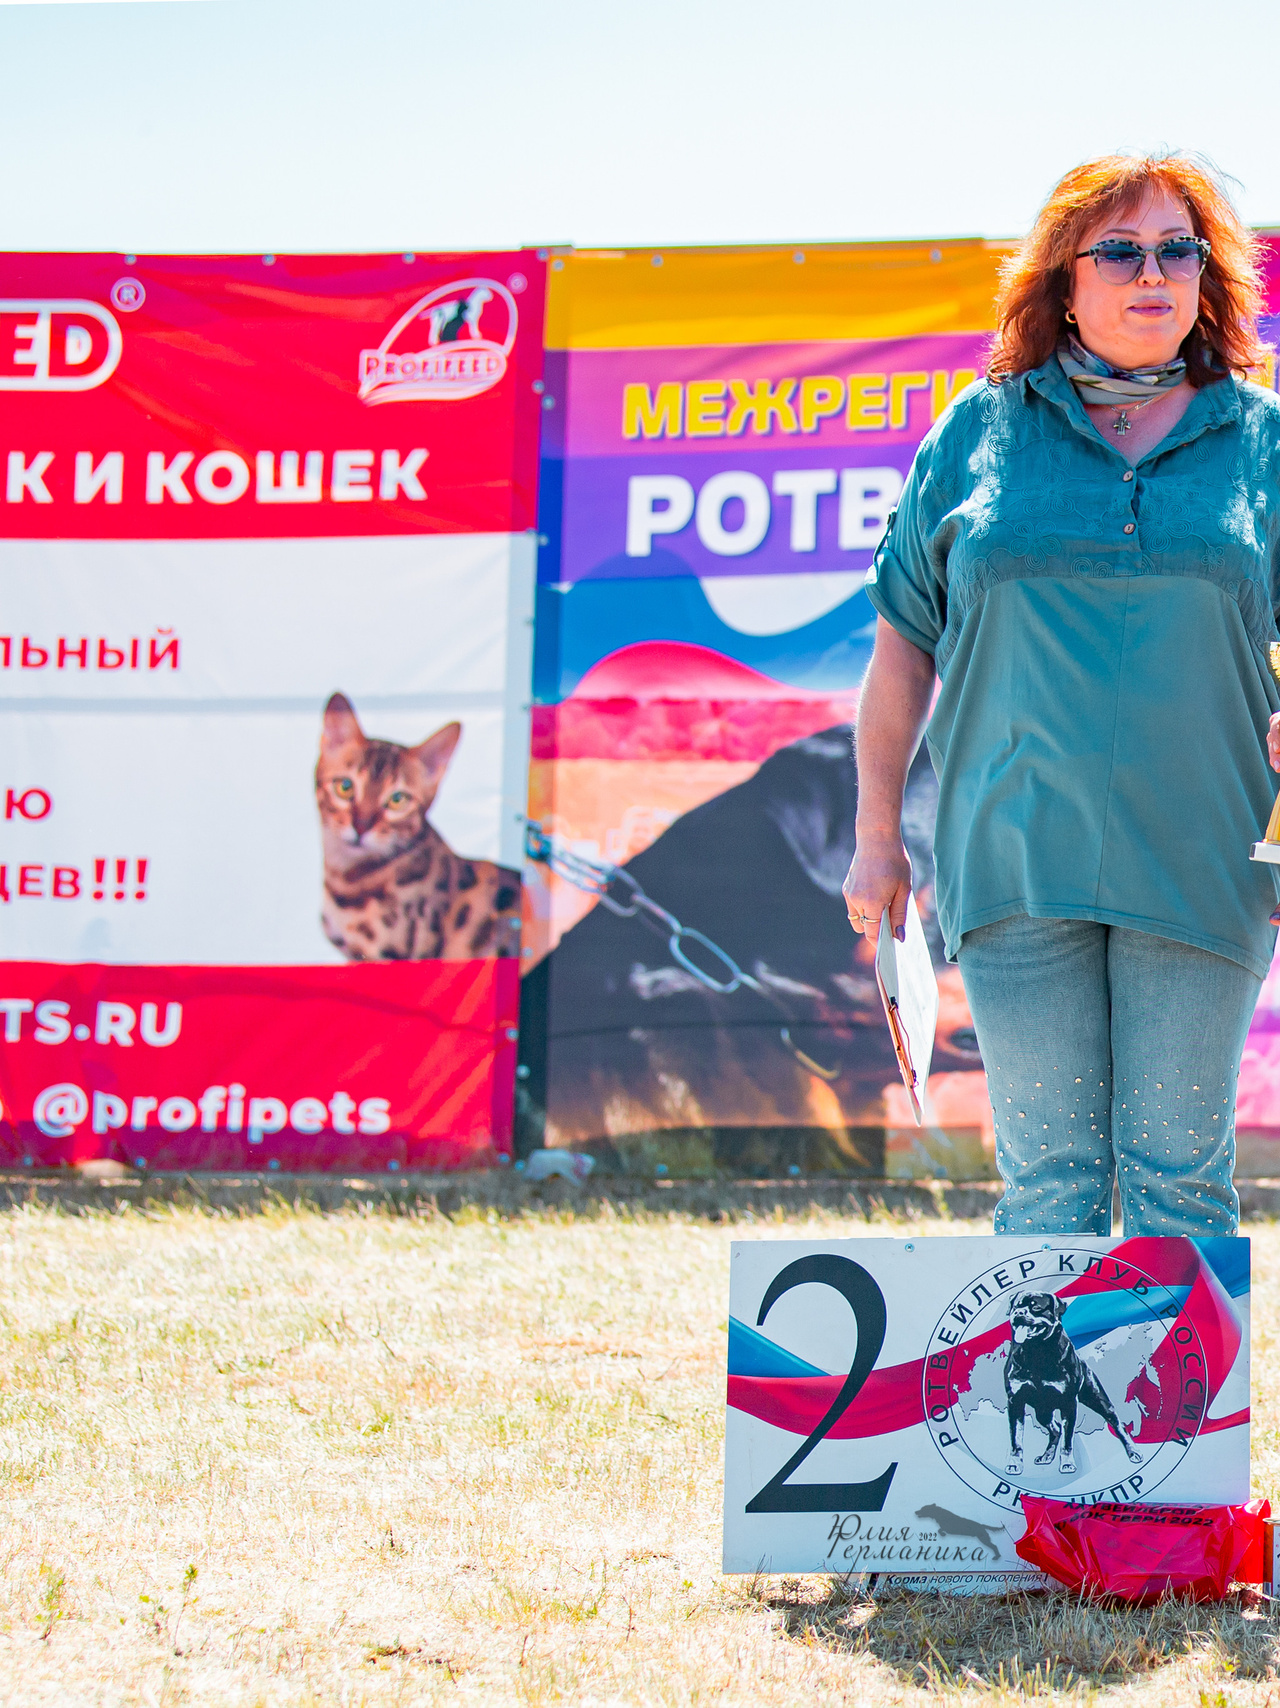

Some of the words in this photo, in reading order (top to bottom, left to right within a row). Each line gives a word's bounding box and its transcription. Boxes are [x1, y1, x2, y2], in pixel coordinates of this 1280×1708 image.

[74, 451, 125, 504] И
[146, 448, 430, 505] КОШЕК
[4, 786, 53, 821] Ю
[0, 997, 183, 1048] TS.RU
[33, 1082, 391, 1145] @profipets
[927, 1258, 1036, 1448] РОТВЕЙЛЕР
[1058, 1253, 1153, 1296] КЛУБ
[1159, 1302, 1204, 1448] РОССИИ
[745, 1252, 899, 1514] 2
[1169, 1516, 1214, 1527] 2022
